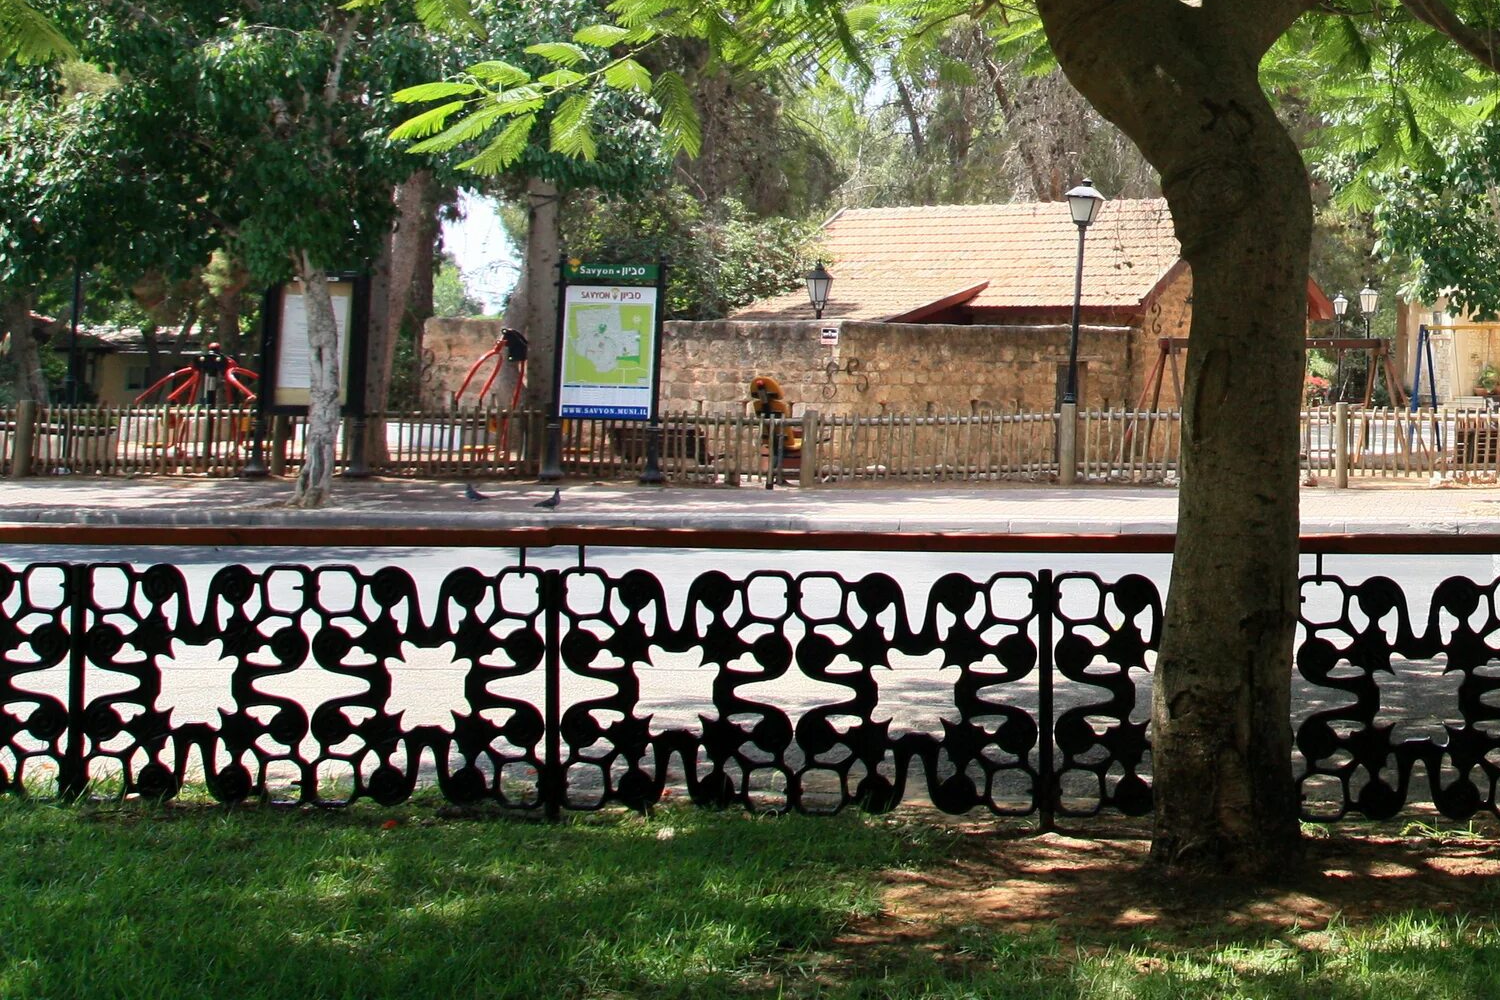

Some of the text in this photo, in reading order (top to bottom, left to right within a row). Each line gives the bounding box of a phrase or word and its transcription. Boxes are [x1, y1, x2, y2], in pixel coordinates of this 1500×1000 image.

[580, 266, 614, 276] Savyon
[622, 267, 645, 276] סביון
[581, 291, 610, 299] SAVYON
[621, 292, 641, 301] סביון
